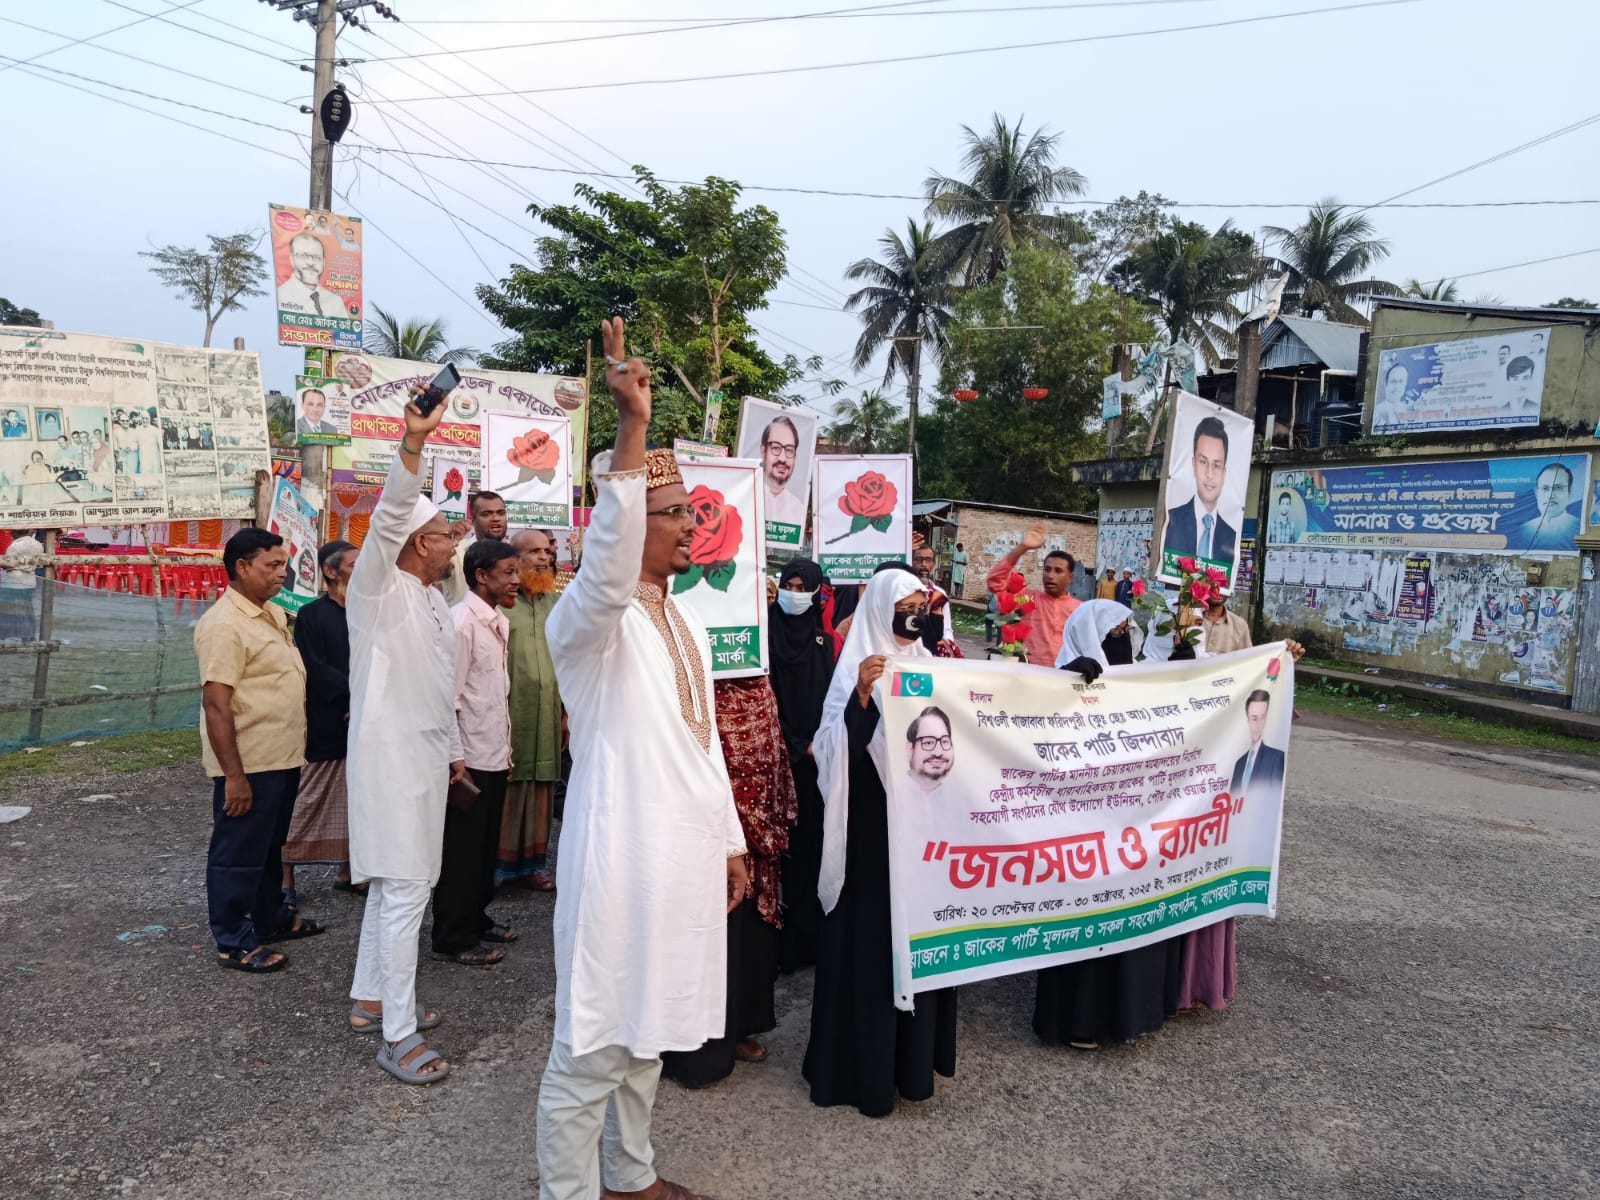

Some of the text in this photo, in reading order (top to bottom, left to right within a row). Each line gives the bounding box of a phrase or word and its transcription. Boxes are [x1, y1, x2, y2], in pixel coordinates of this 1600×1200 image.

[282, 327, 333, 344] সভাপতি
[352, 416, 401, 435] প্রাথমিক
[122, 507, 140, 516] আল
[1333, 511, 1501, 534] সালাম ও শুভেচ্ছা
[1347, 533, 1357, 544] বি
[1359, 534, 1375, 545] এম
[823, 555, 852, 566] জাকের
[854, 553, 879, 566] পার্টির
[826, 568, 856, 577] গোলাপ
[721, 627, 753, 646] মার্কা
[715, 646, 747, 665] মার্কা
[968, 691, 993, 704] ইসলাম
[1011, 714, 1046, 728] খাজাবাবা
[1046, 712, 1086, 730] ফরিদপুরী
[1151, 704, 1182, 719] ছাহেব
[1189, 695, 1231, 713] জিন্দাবাদ
[1033, 726, 1185, 762] জাকের পার্টি জিন্দাবাদ
[1000, 768, 1036, 781] জাকের
[1038, 767, 1067, 782] পার্টির
[1068, 763, 1101, 781] মাননীয়
[1102, 760, 1144, 777] চেয়ারম্যান
[1144, 754, 1182, 770] মহোদয়ের
[989, 783, 1015, 803] কেন্দ্রীয়
[1015, 781, 1055, 801] কর্মসূচীর
[1056, 780, 1118, 798] ধারাবাহিকতায়
[1118, 776, 1146, 791] জাকের
[1147, 770, 1168, 787] পার্টি
[1188, 767, 1195, 778] ও
[1195, 763, 1218, 776] সকল
[969, 805, 1011, 825] সহযোগী
[1010, 800, 1047, 822] সংগঠনের
[1048, 799, 1068, 816] যৌথ
[1068, 797, 1104, 813] উদ্যোগে
[1105, 791, 1144, 811] ইউনিয়ন,
[1166, 787, 1182, 800] এবং
[1183, 778, 1208, 797] ওয়ার্ড
[1117, 826, 1149, 871] ও
[971, 905, 988, 919] ২০
[991, 900, 1037, 916] সেপ্টেম্বর
[1037, 898, 1065, 913] থেকে
[1074, 896, 1089, 907] ৩০
[1091, 888, 1126, 905] অক্টোবর,
[1128, 882, 1152, 898] ২০২৫
[1166, 871, 1183, 886] সময়
[1199, 866, 1205, 876] ২
[1204, 860, 1214, 873] টা
[963, 937, 1007, 959] জাকের
[1010, 926, 1042, 950] পার্টি
[1041, 926, 1082, 951] মূলদল
[1084, 926, 1094, 939] ও
[1097, 917, 1124, 937] সকল
[1127, 901, 1167, 931] সহযোগী
[1201, 880, 1238, 908] বাগেরহাট
